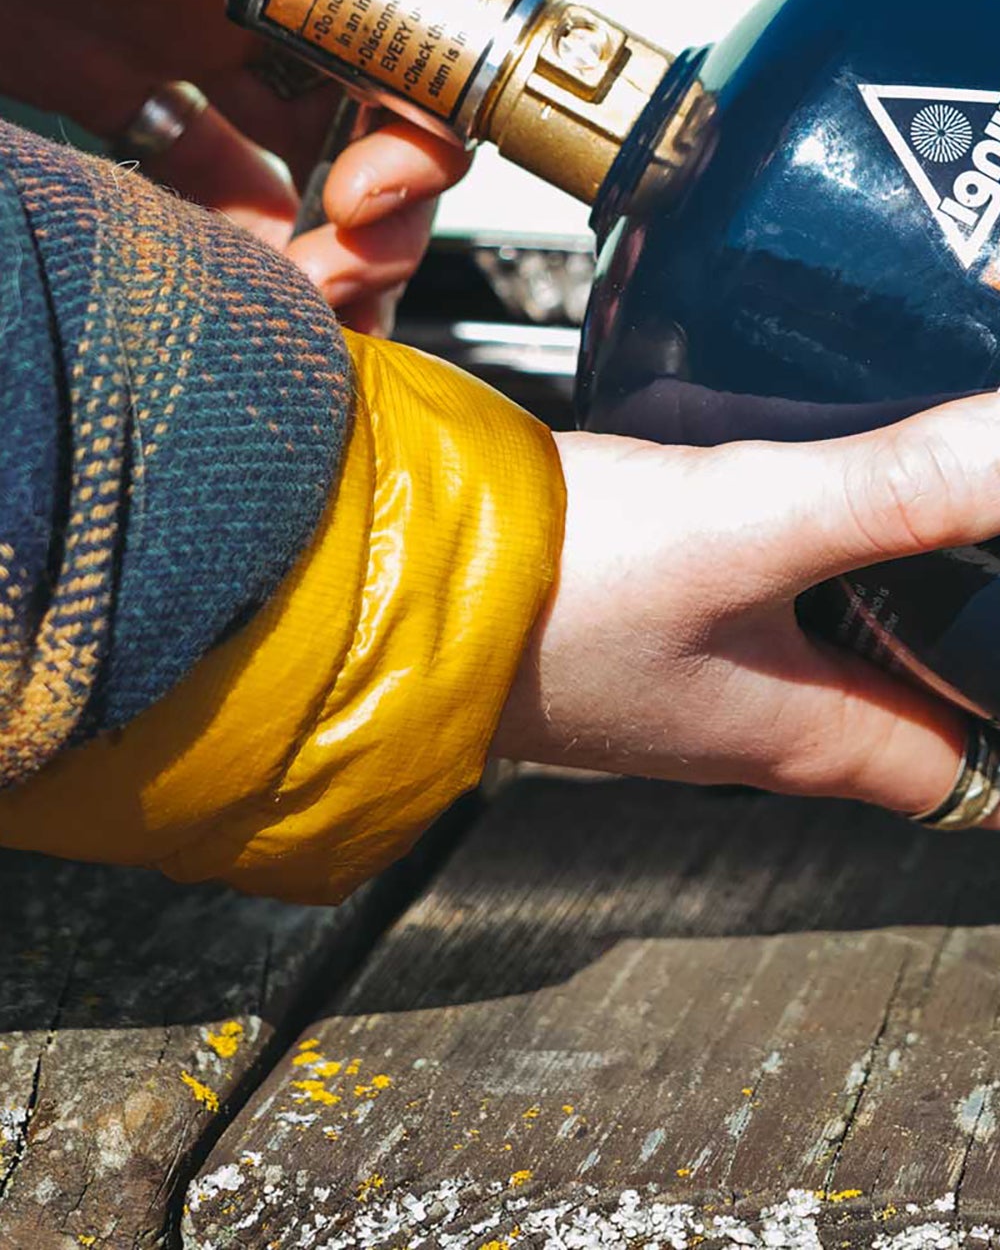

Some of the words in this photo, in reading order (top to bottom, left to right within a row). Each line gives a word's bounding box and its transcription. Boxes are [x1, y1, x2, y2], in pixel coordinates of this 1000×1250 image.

[315, 13, 334, 35] Do
[346, 12, 361, 32] an
[382, 21, 413, 71] EVERY
[404, 39, 434, 84] Check
[428, 64, 452, 97] stem
[443, 45, 459, 63] is
